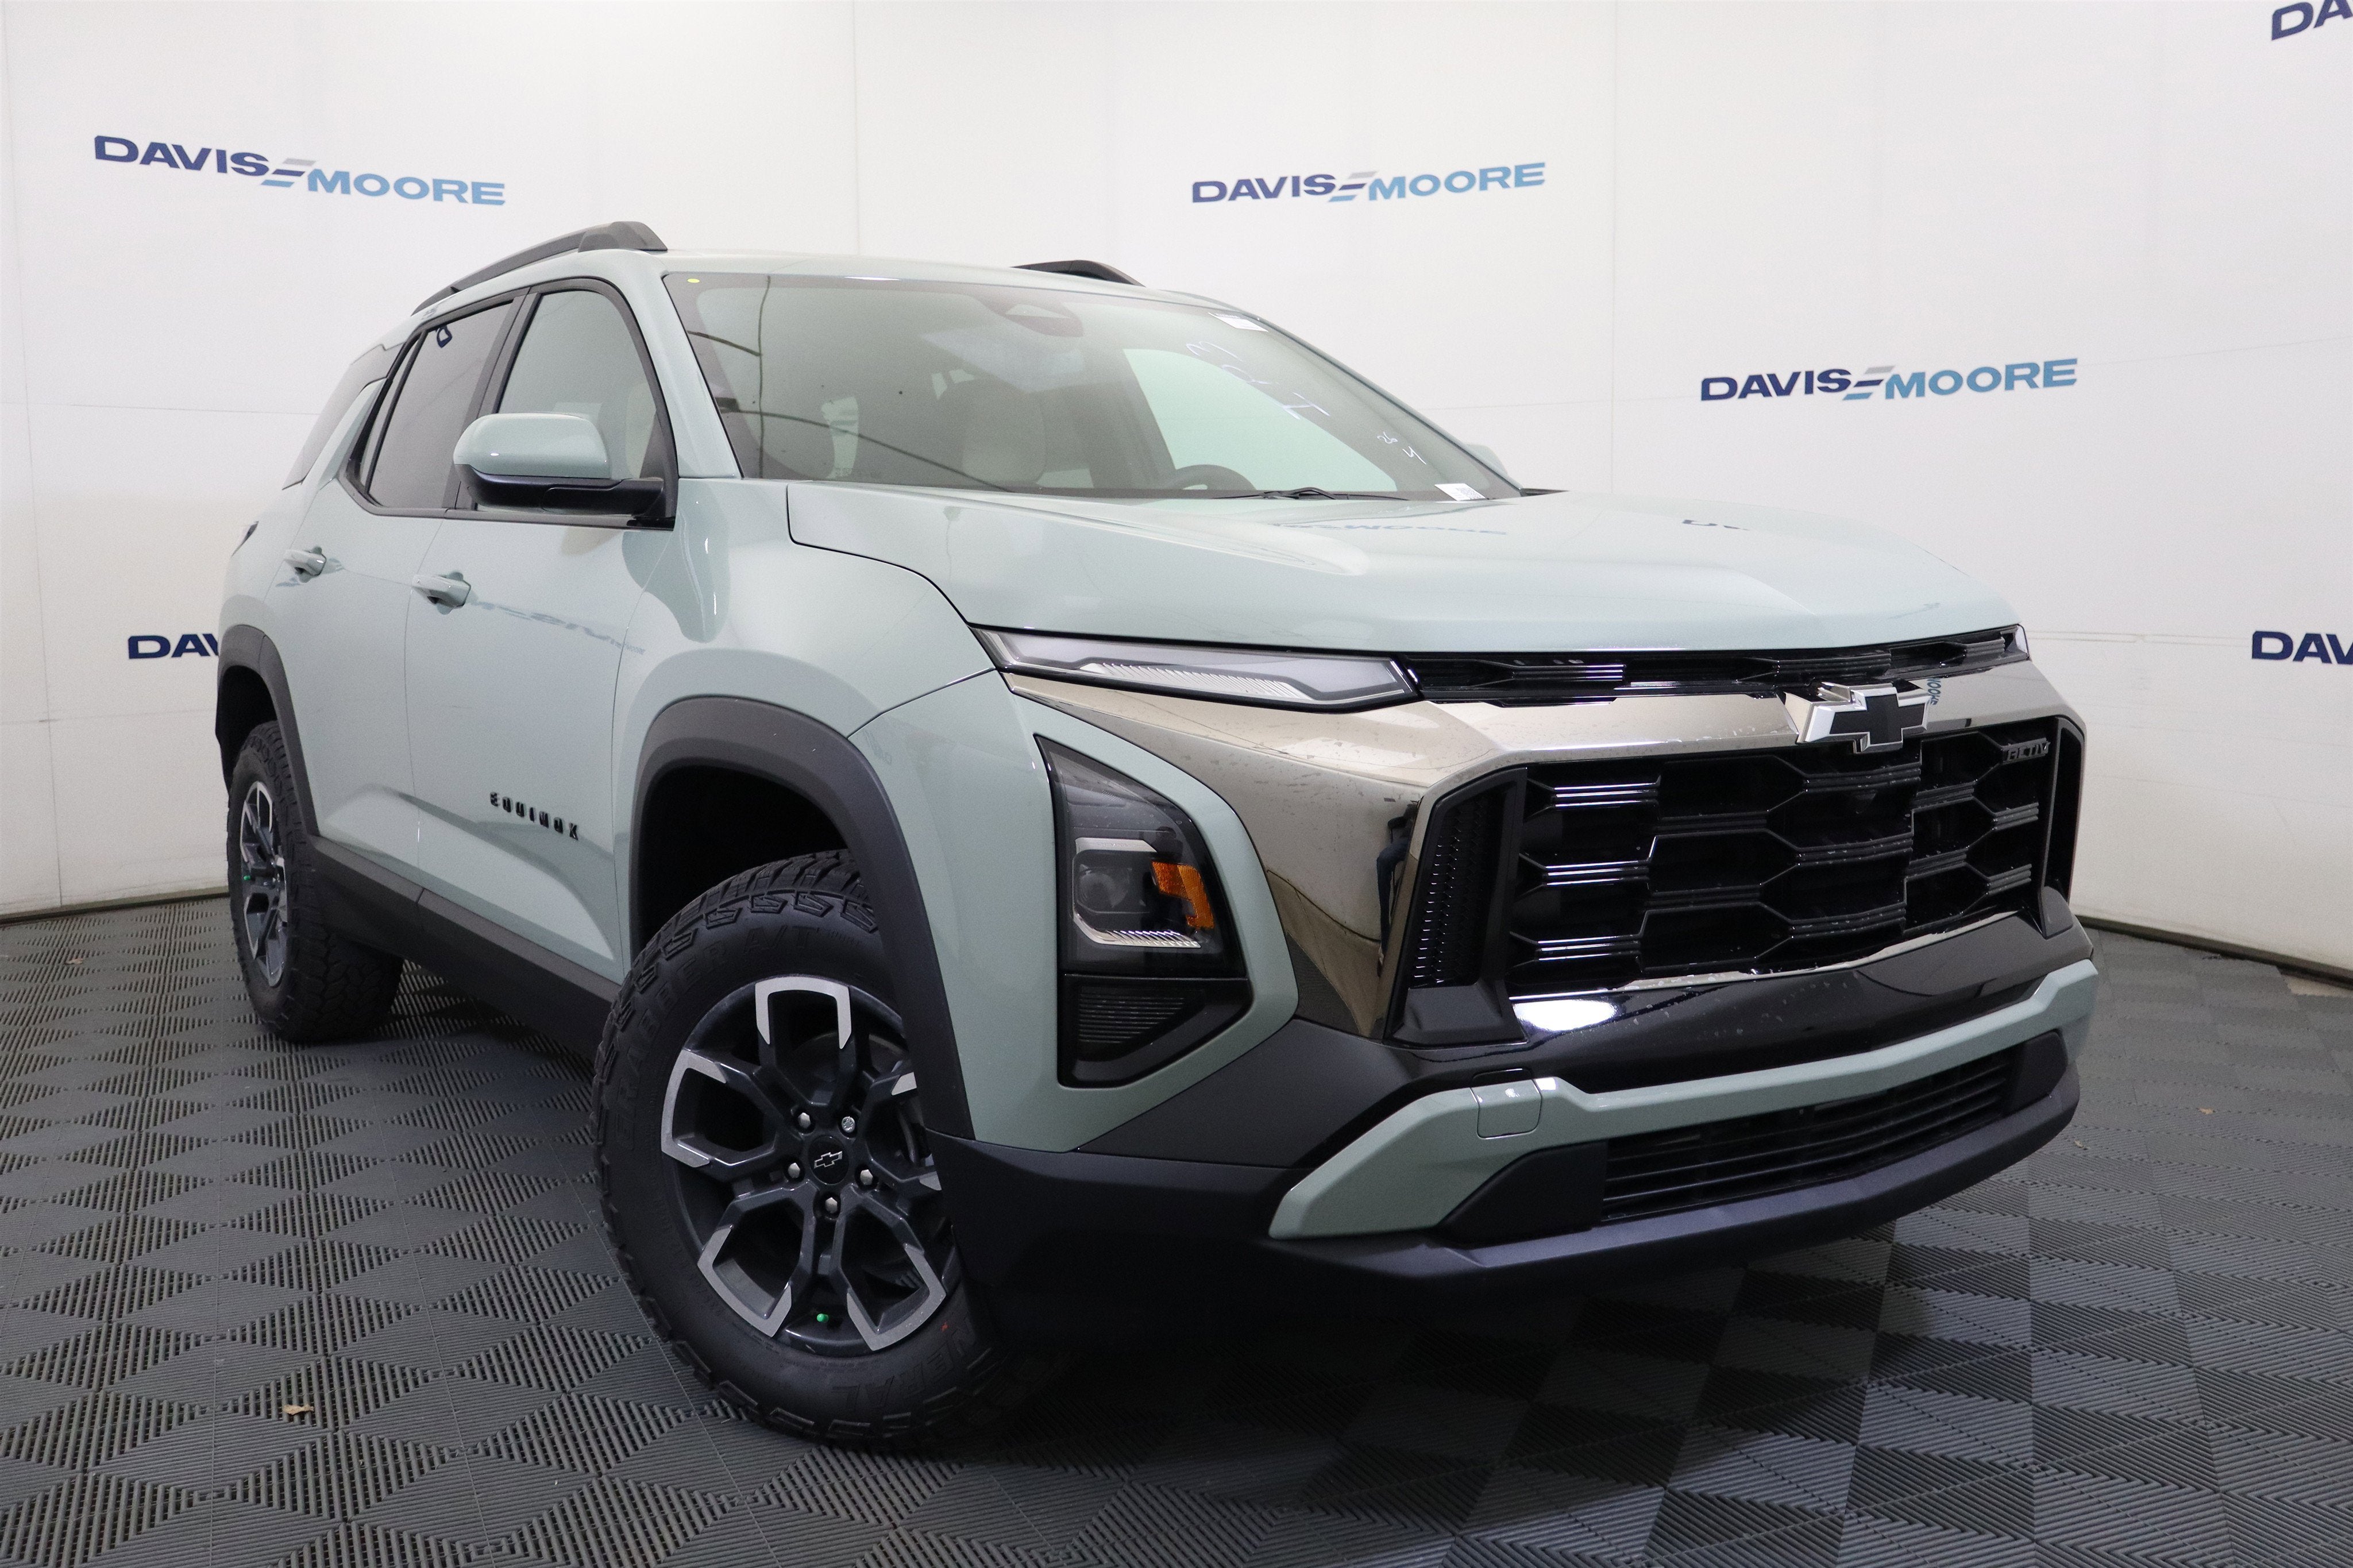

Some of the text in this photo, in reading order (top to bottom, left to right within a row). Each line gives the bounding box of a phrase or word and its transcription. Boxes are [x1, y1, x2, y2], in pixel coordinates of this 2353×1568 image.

[94, 135, 506, 206] DAVIS MOORE
[1191, 162, 1546, 203] DAVIS MOORE
[1700, 357, 2078, 401] DAVIS MOORE
[489, 791, 579, 841] EQUINOX
